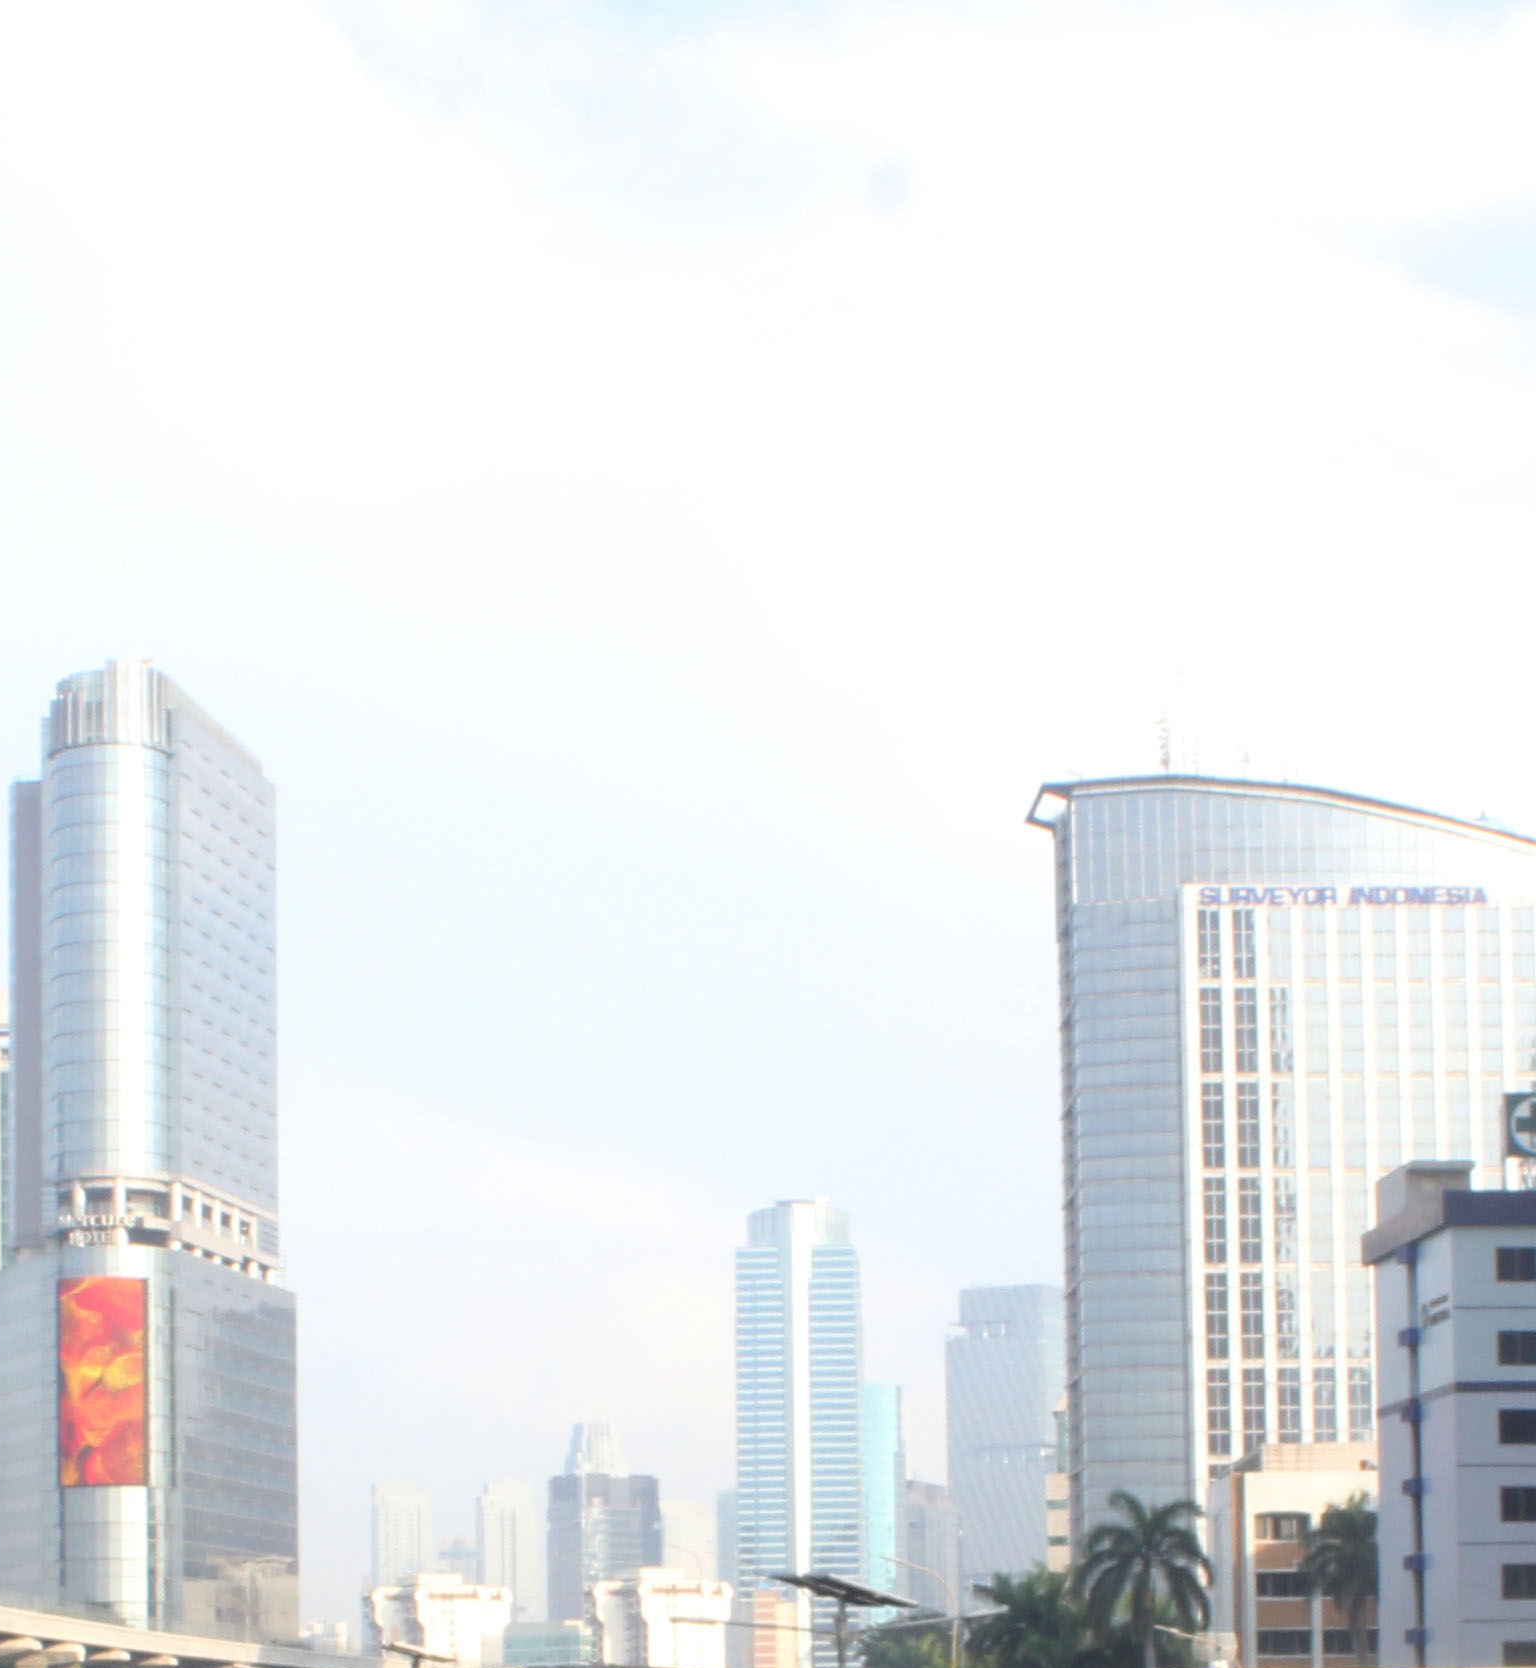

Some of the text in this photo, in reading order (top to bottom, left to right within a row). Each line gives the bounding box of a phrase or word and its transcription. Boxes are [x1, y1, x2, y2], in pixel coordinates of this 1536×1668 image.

[1198, 886, 1488, 905] SURVEYOR INDONESIA
[69, 1230, 117, 1245] HOTE
